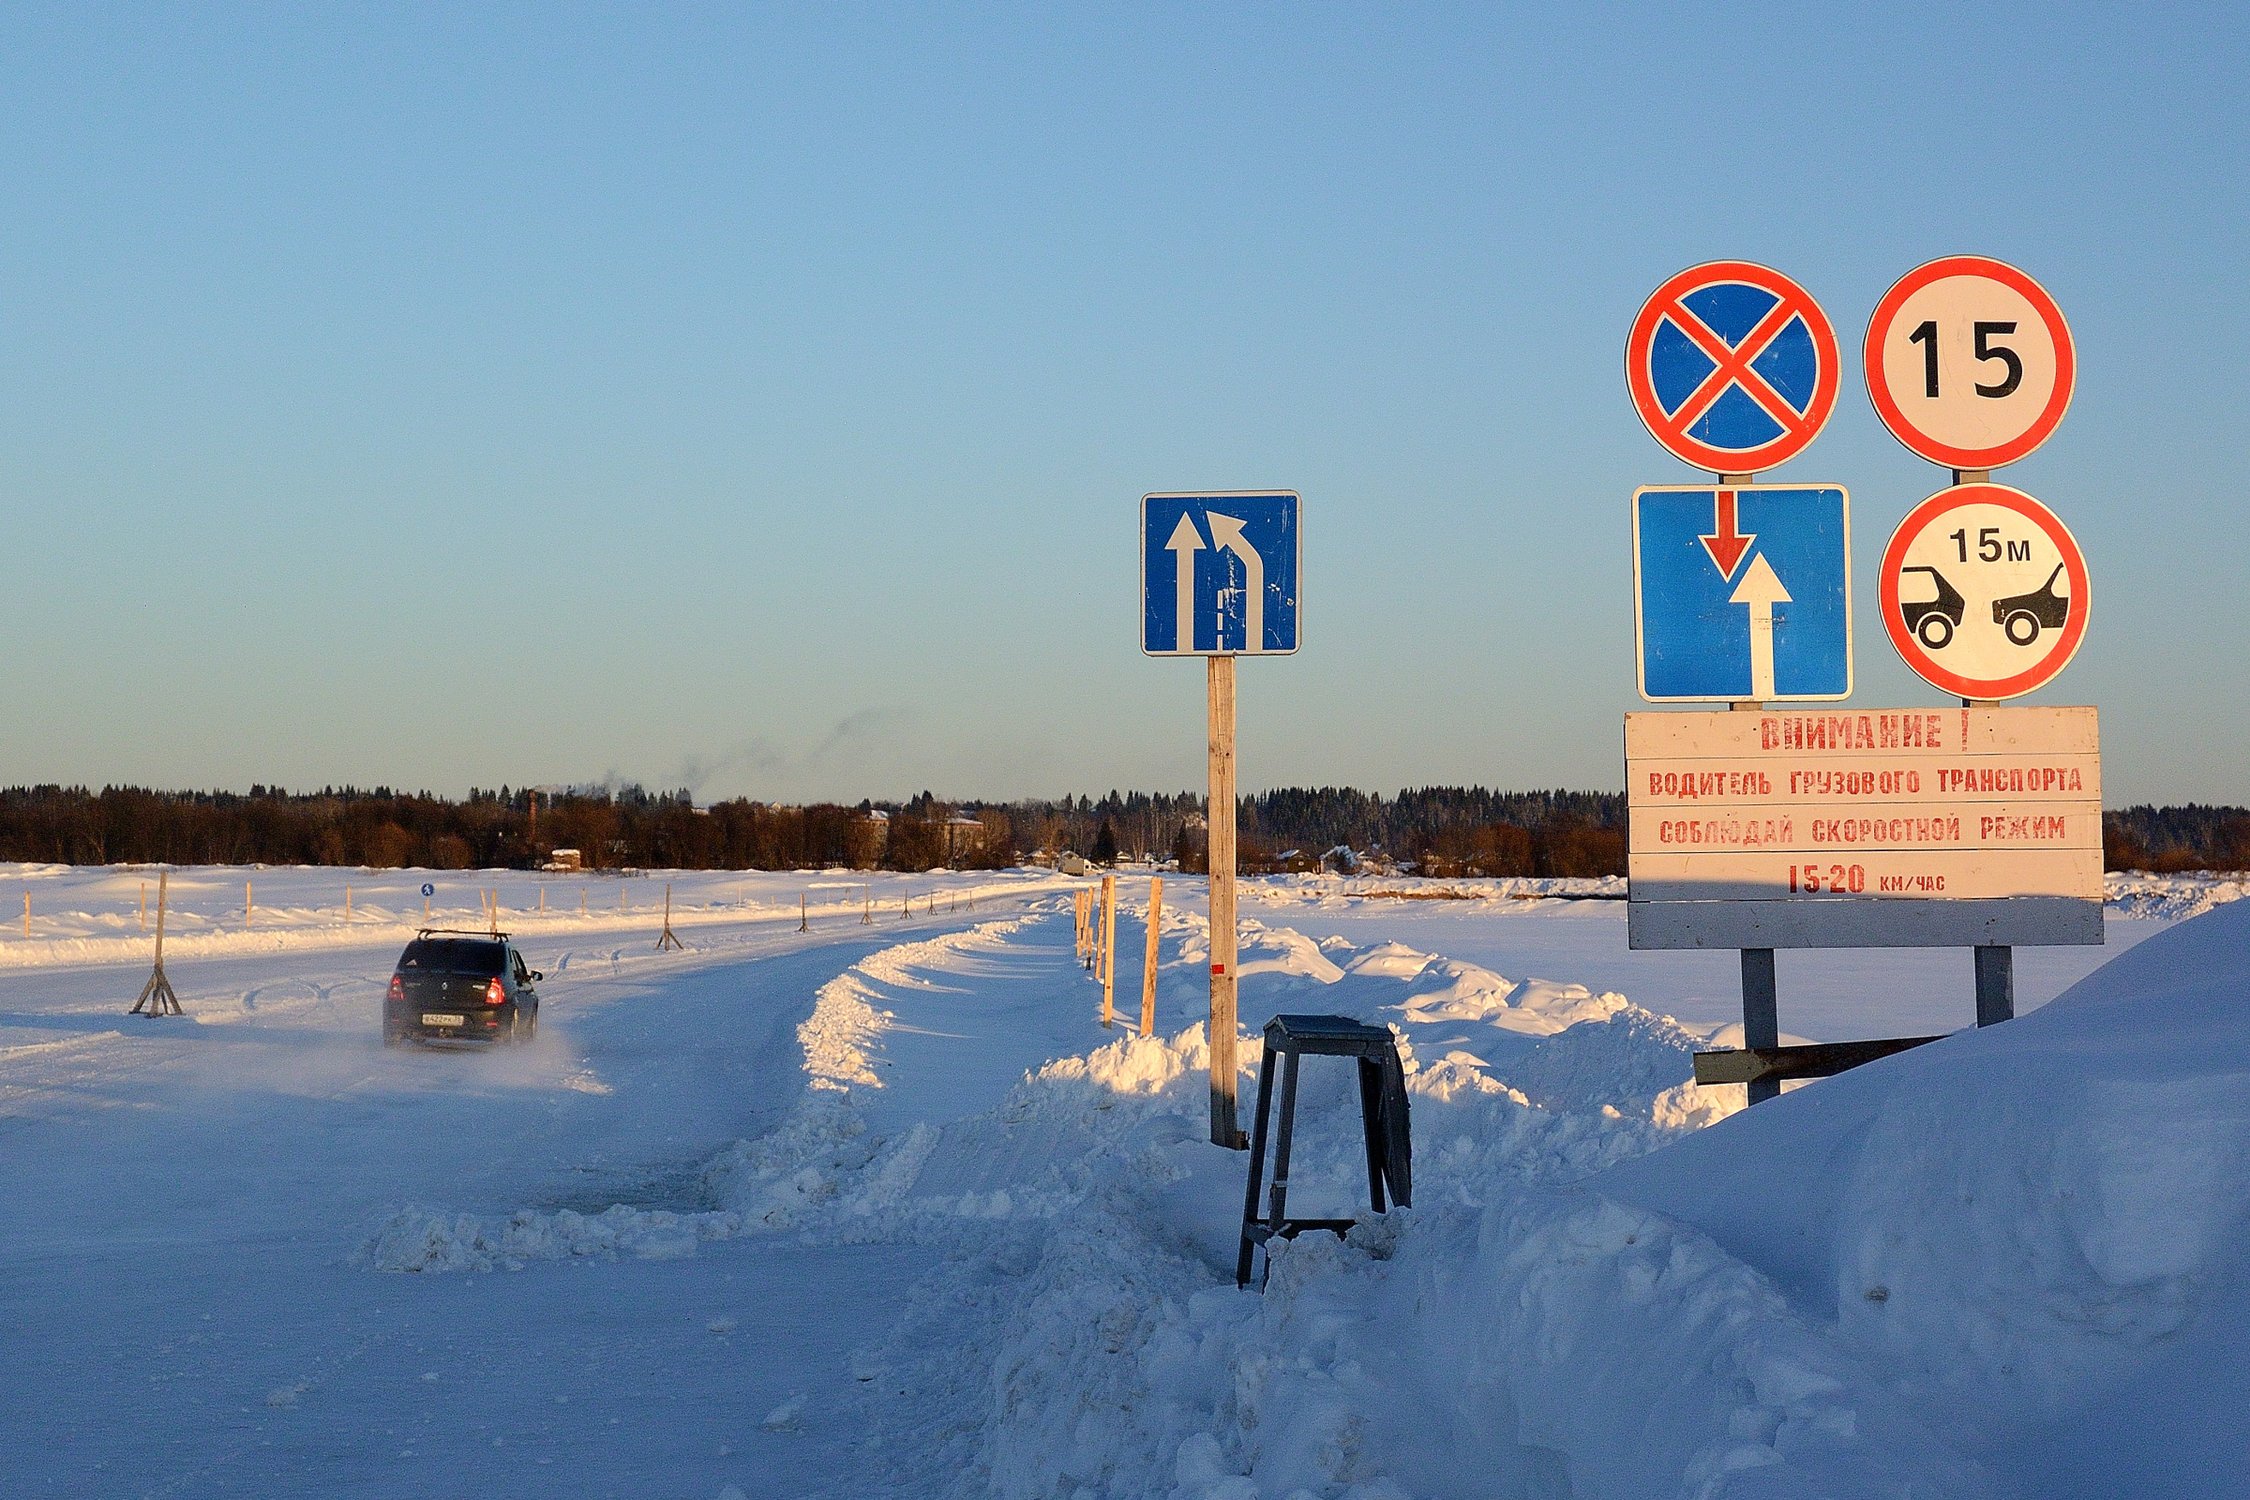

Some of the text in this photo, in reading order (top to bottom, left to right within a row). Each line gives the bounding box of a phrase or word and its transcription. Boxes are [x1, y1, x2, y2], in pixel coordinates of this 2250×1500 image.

[1908, 320, 2024, 399] 15
[1760, 715, 1942, 750] ВНИМАНИЕ
[1649, 767, 2083, 799] ВОДИТЕЛЬ ГРУЗОВОГО ТРАНСПОРТА
[1659, 812, 2066, 846] СОБЛЮДАЙ СКОРОСТНОЙ РЕЖИМ
[1789, 864, 1946, 893] 15-20 КМ/ЧАС
